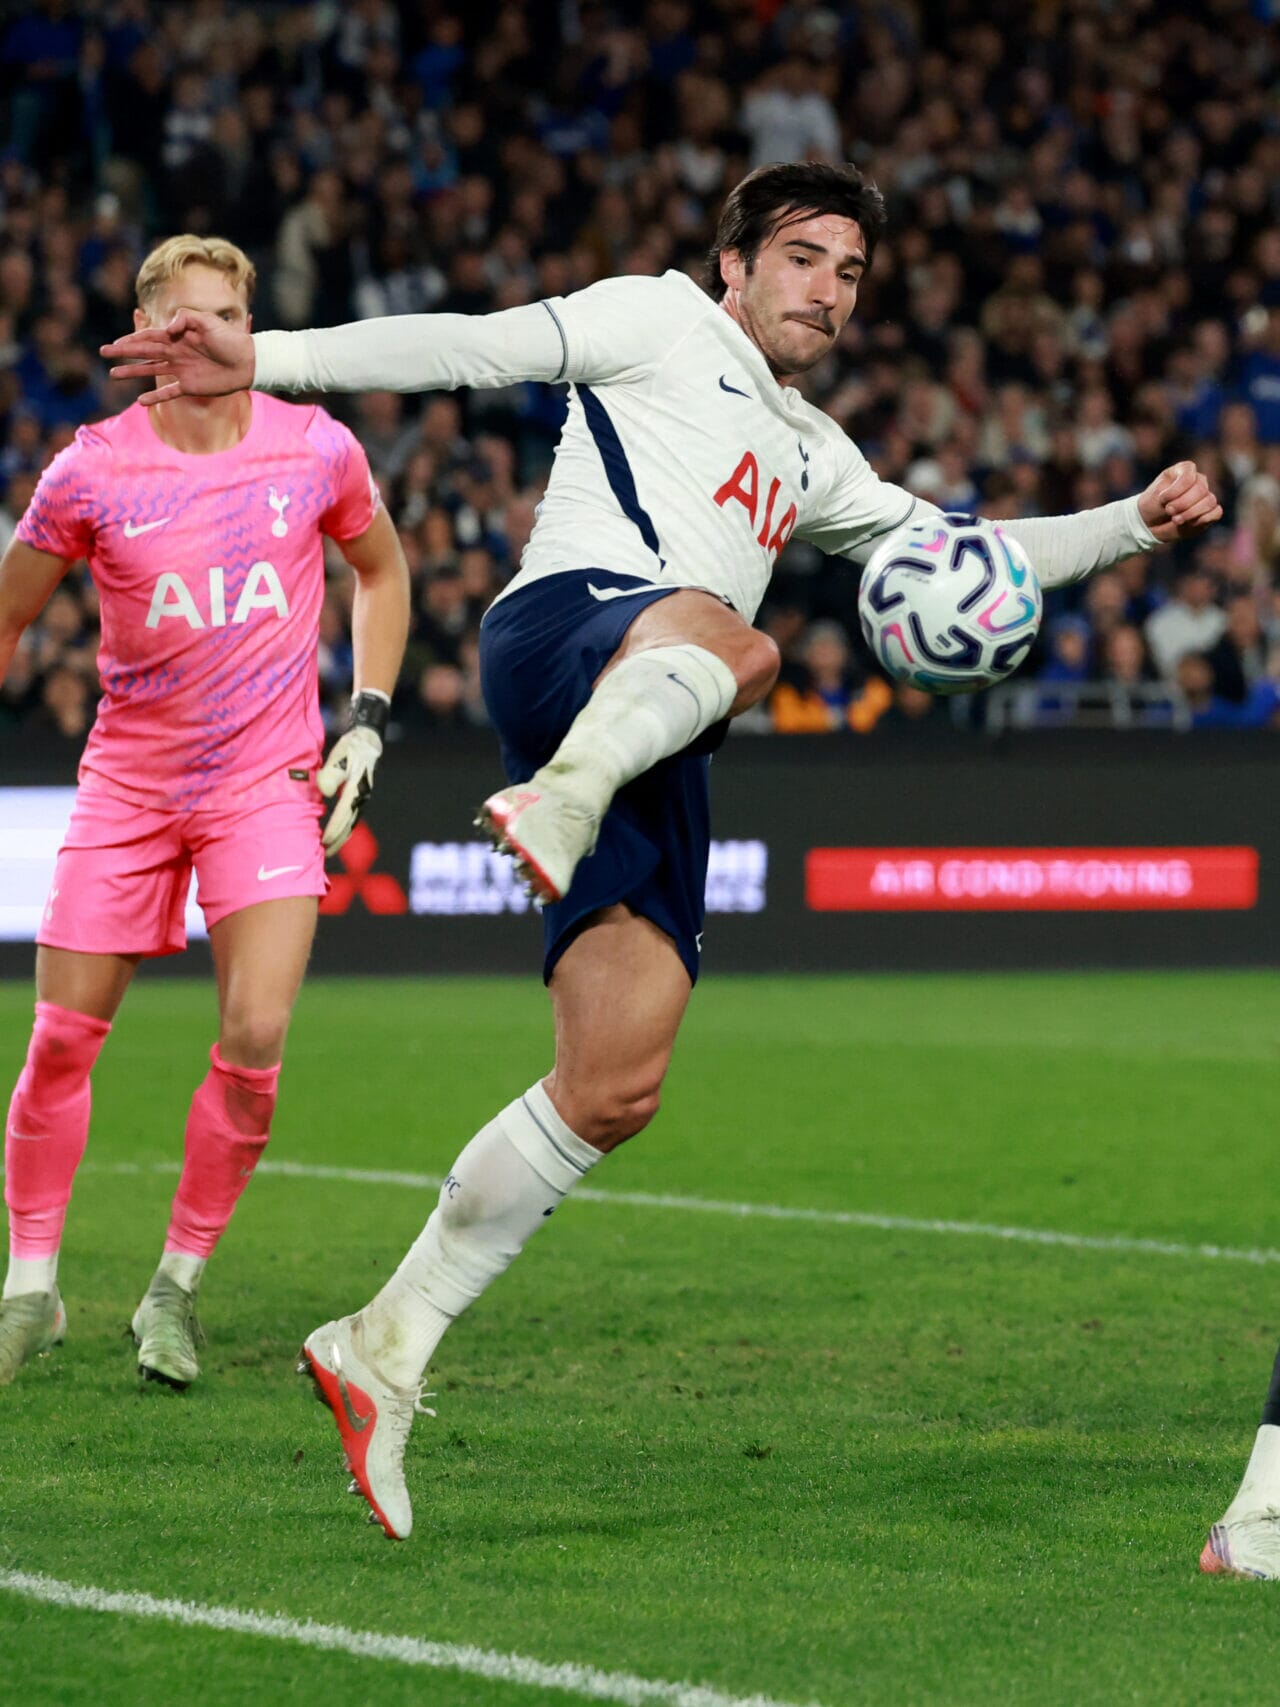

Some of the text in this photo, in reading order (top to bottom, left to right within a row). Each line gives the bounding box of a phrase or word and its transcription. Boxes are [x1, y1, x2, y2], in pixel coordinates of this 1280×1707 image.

[712, 450, 797, 557] AIA
[144, 560, 289, 629] AIA
[870, 859, 1193, 898] AIR CONDITIONING
